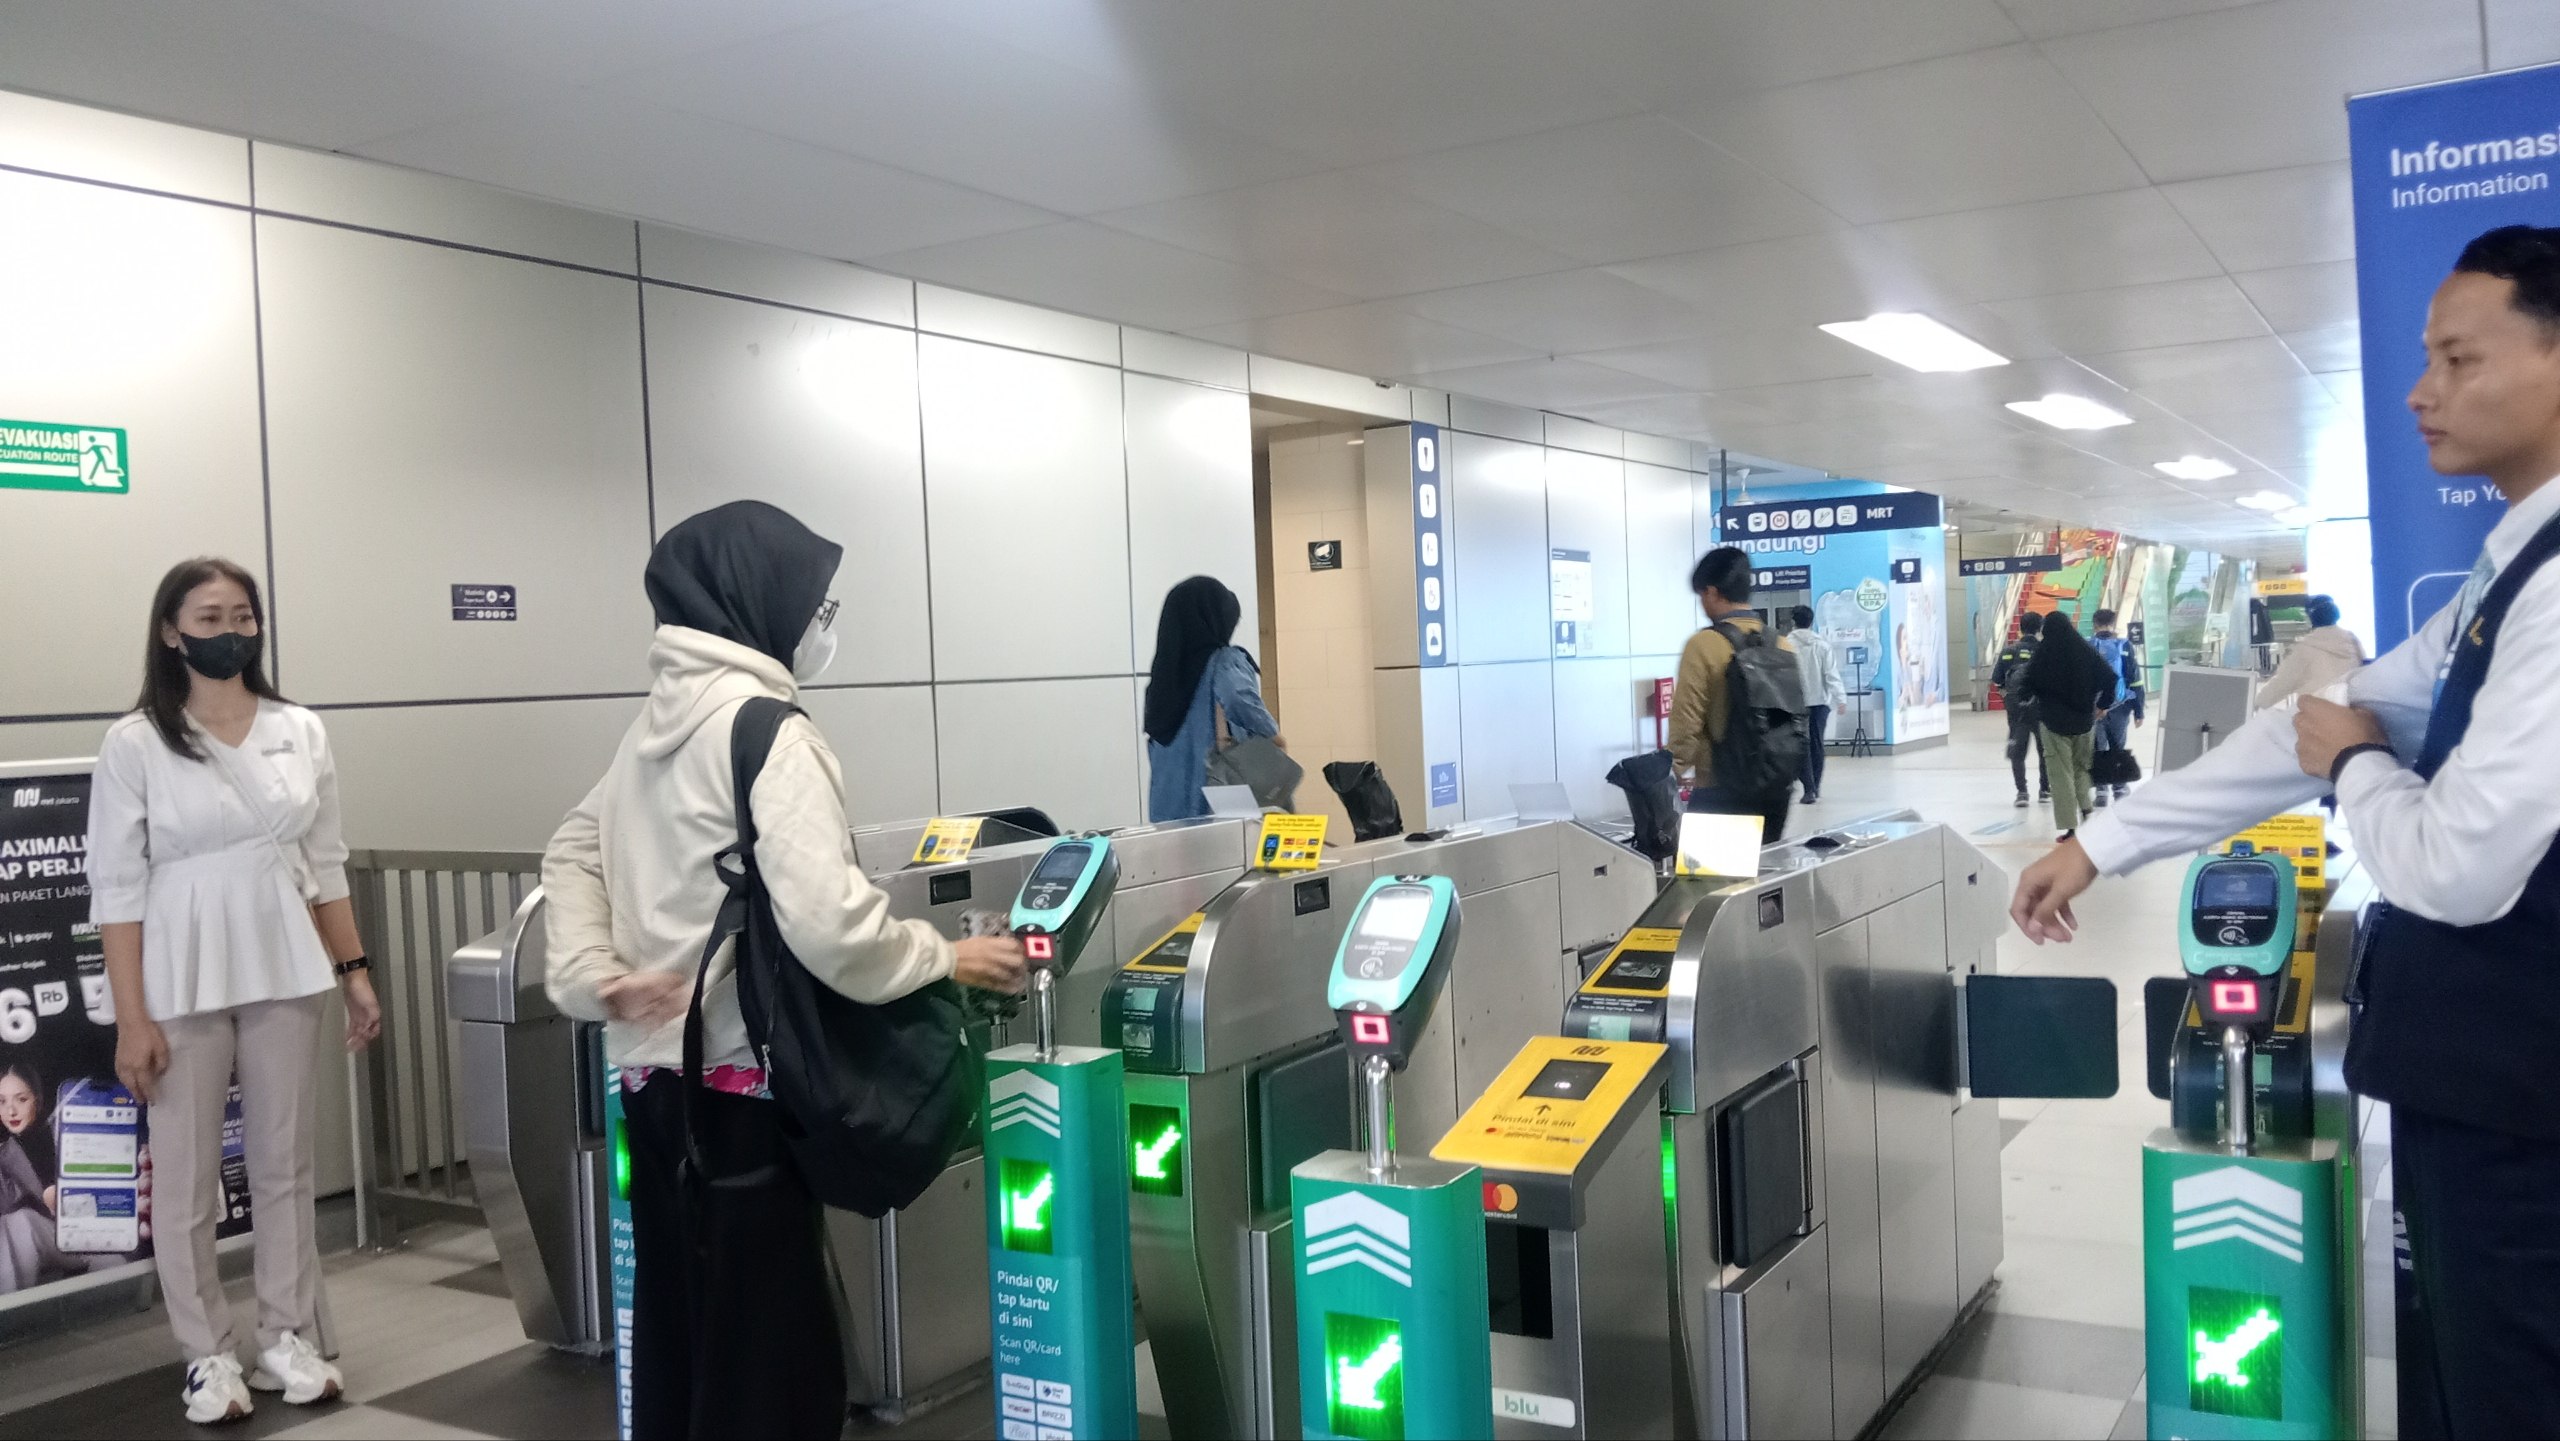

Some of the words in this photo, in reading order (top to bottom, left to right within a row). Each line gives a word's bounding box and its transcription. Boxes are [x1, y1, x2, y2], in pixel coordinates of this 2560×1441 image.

[2391, 132, 2560, 177] Informas
[2392, 172, 2549, 209] Information
[43, 452, 79, 464] ROUTE
[2438, 487, 2477, 507] Tap
[1866, 506, 1895, 519] MRT
[12, 888, 53, 902] PAKET
[41, 990, 64, 1004] Rb
[1492, 1114, 1533, 1125] Pindai
[1535, 1117, 1549, 1126] di
[1551, 1119, 1576, 1128] sini
[614, 1237, 629, 1252] tap
[997, 1270, 1033, 1288] Pindai
[1036, 1276, 1059, 1294] QR/
[998, 1291, 1017, 1308] tap
[1019, 1294, 1050, 1311] kartu
[998, 1312, 1010, 1325] di
[1012, 1315, 1033, 1329] sini
[999, 1334, 1022, 1349] Scan
[1023, 1339, 1062, 1356] QR/card
[1000, 1351, 1021, 1366] here
[1504, 1394, 1540, 1417] blu
